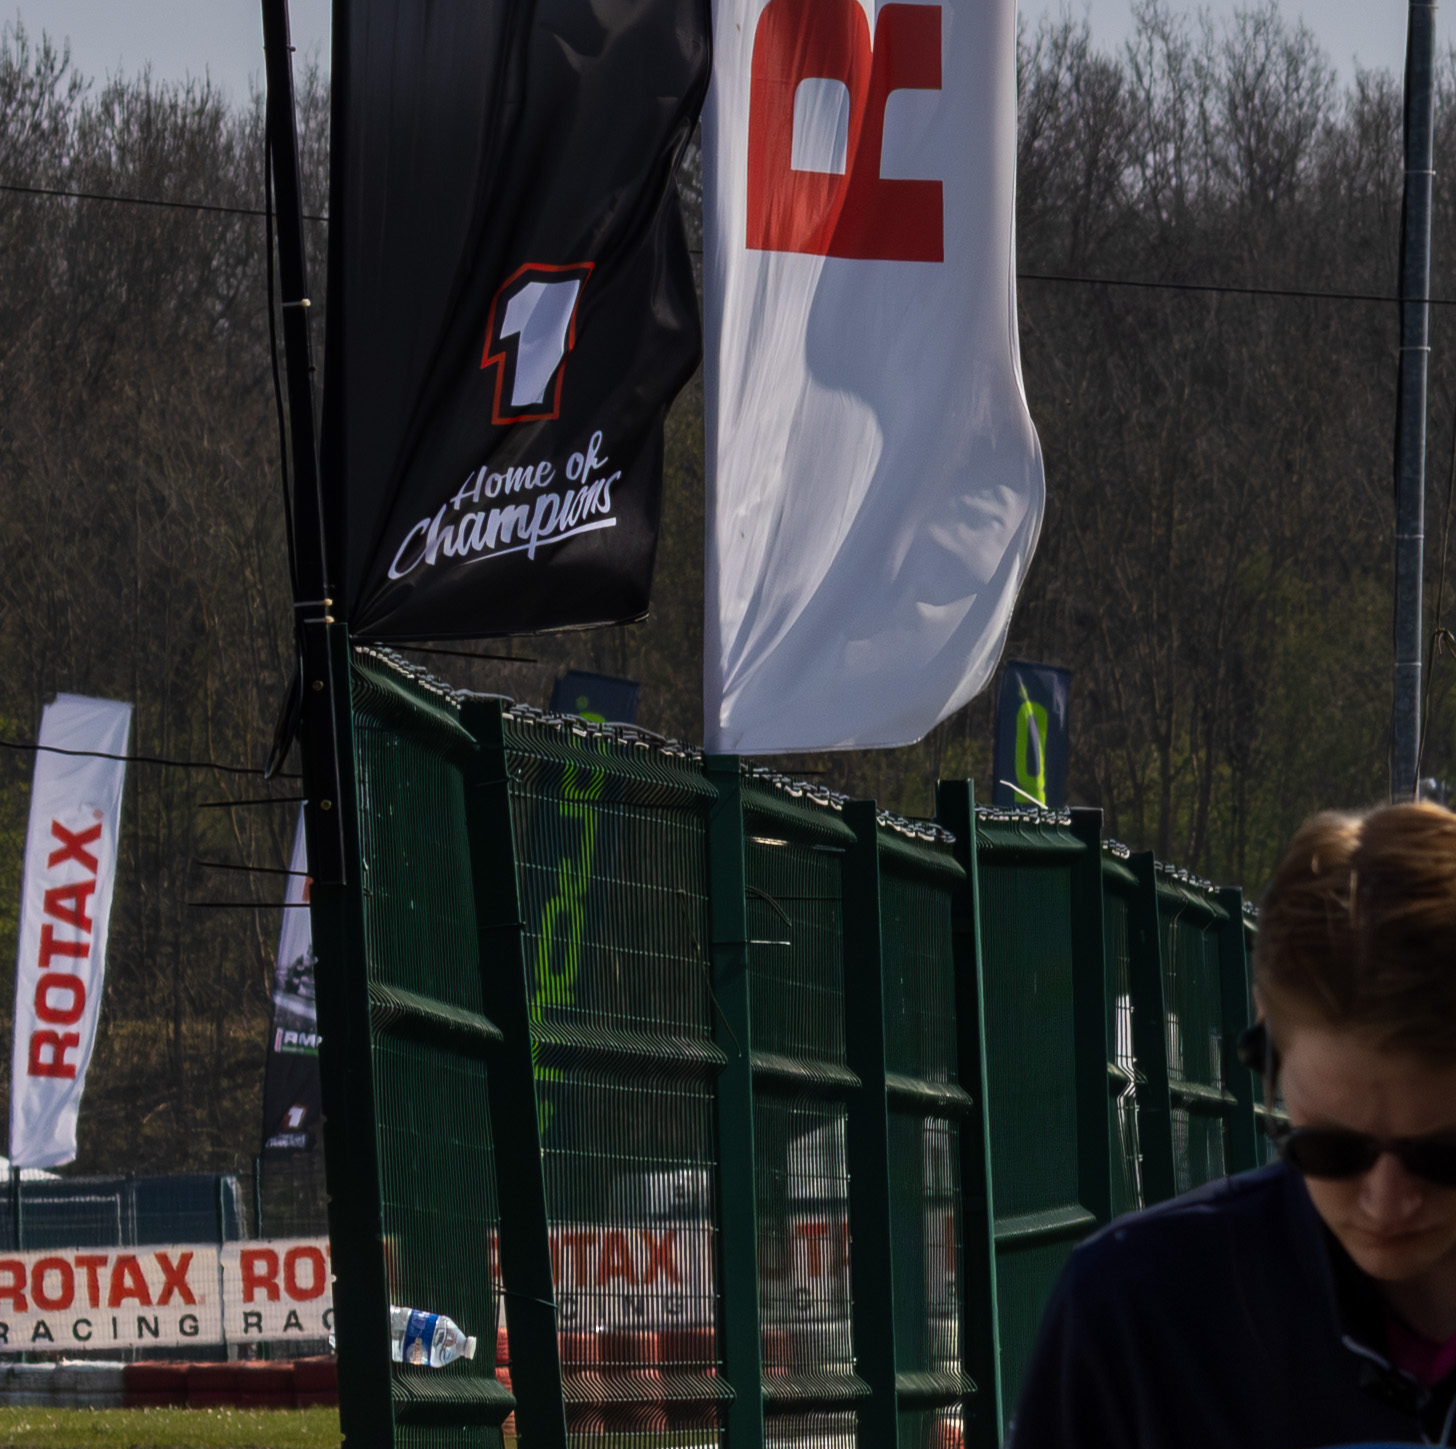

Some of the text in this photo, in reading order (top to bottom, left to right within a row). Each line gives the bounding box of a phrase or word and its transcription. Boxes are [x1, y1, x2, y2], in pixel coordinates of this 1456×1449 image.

[492, 270, 586, 414] 1
[388, 470, 621, 579] Champions
[450, 430, 608, 510] Home of
[27, 818, 102, 1080] ROTAX
